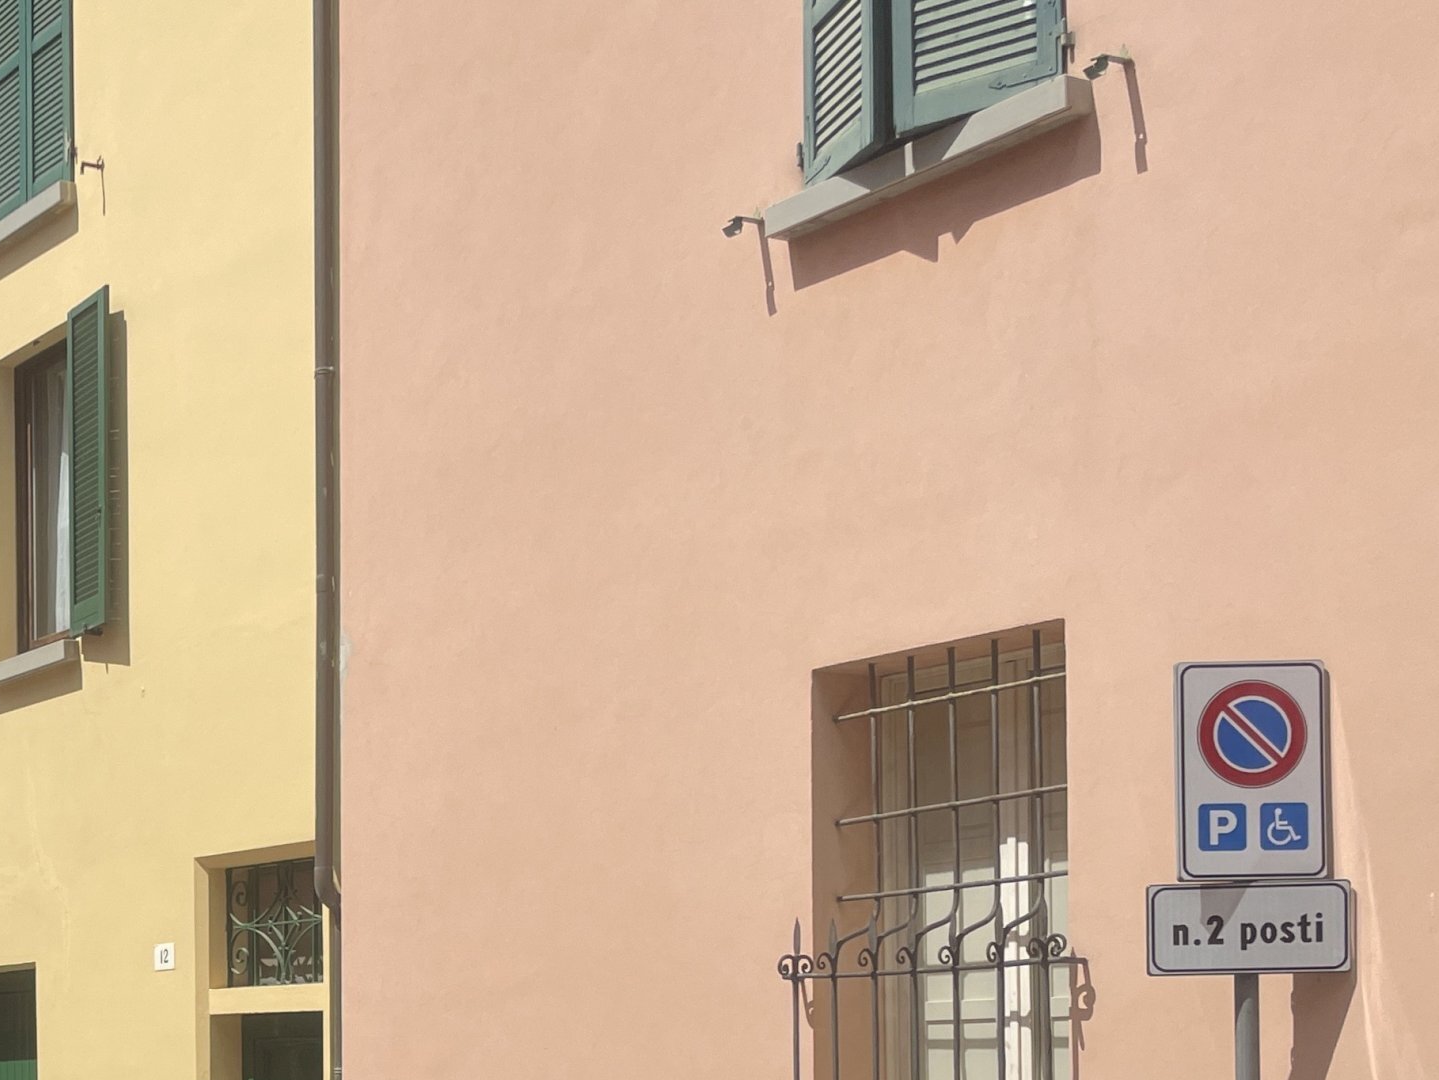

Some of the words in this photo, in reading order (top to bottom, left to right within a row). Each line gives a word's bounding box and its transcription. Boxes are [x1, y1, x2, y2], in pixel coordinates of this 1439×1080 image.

[1209, 810, 1237, 845] P
[1172, 915, 1224, 946] n.2
[1240, 912, 1323, 950] posti
[160, 948, 169, 964] 12
